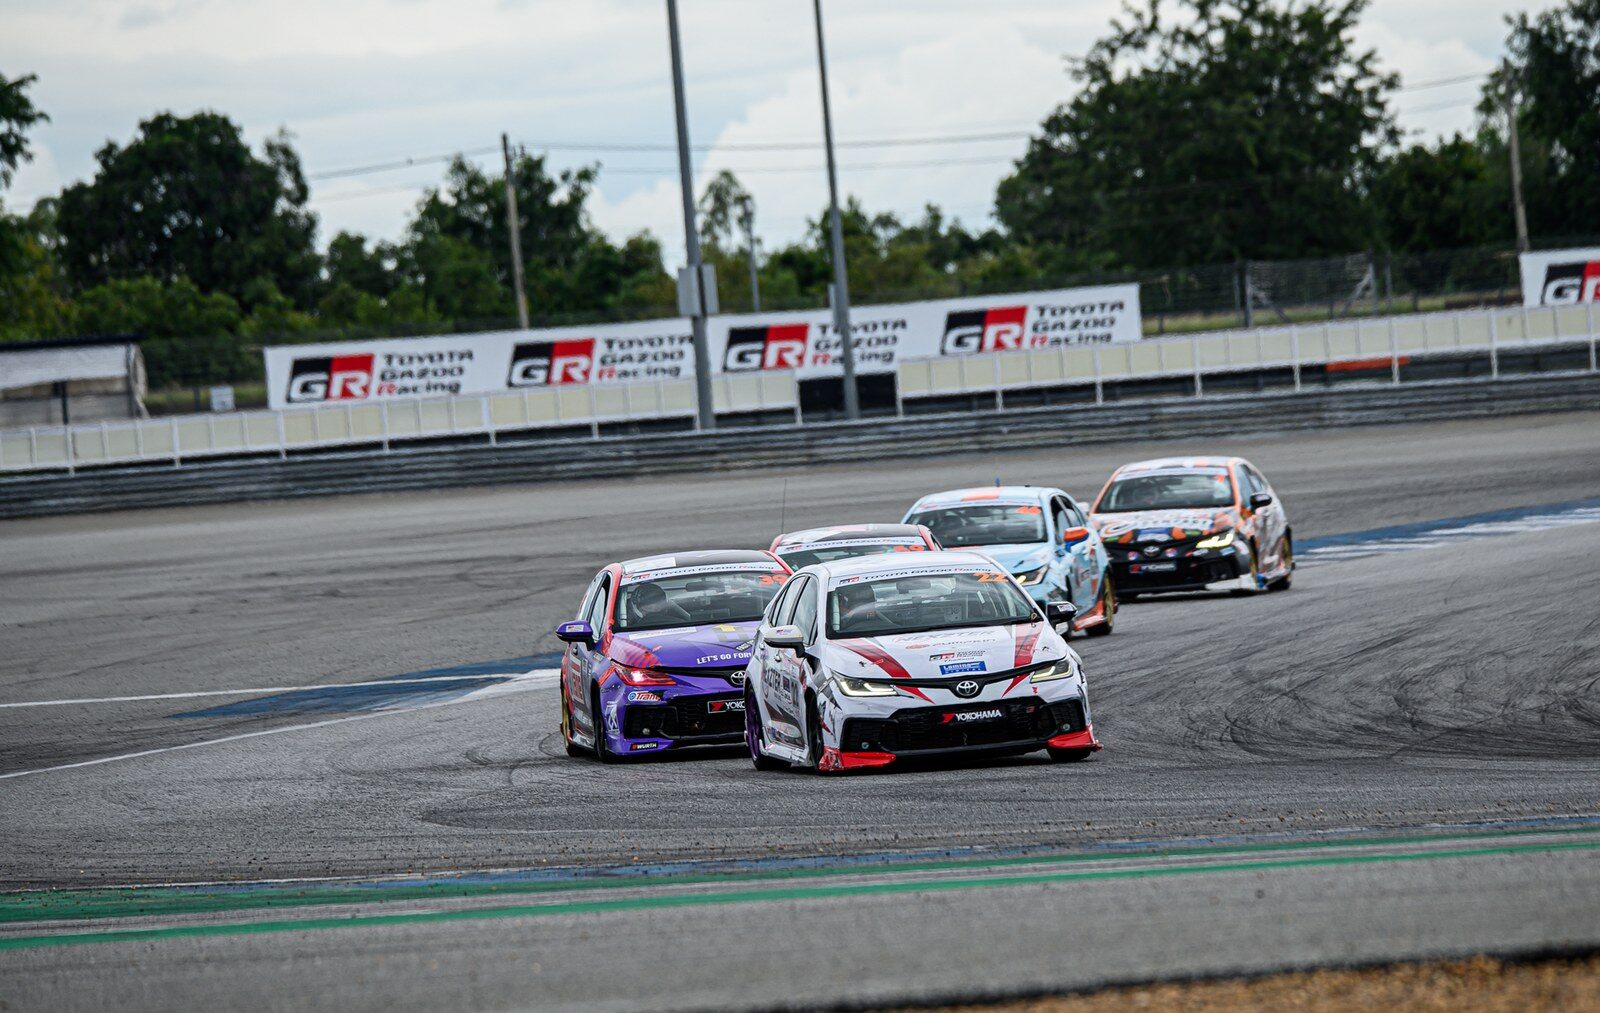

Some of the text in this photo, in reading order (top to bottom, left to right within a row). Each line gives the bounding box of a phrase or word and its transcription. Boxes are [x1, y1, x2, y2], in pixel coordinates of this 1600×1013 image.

[1037, 301, 1124, 317] TOYOTA
[1032, 316, 1116, 333] GAZOO
[944, 323, 1022, 352] GR
[1030, 332, 1112, 347] Racing
[384, 349, 474, 366] TOYOTA
[600, 349, 685, 366] GAZOO
[726, 340, 805, 370] GR
[812, 350, 896, 366] Raing
[380, 365, 465, 382] GAZOO
[510, 354, 591, 386] GR
[597, 366, 682, 380] Racing
[289, 370, 370, 401] GR
[376, 381, 462, 396] Racing
[654, 569, 696, 577] TOYOTA
[758, 574, 788, 586] 39
[864, 571, 908, 580] TOYOTA
[973, 572, 1009, 583] 22
[697, 653, 718, 664] LET'S
[720, 652, 732, 660] GO
[956, 709, 1002, 721] YOKOHAMA
